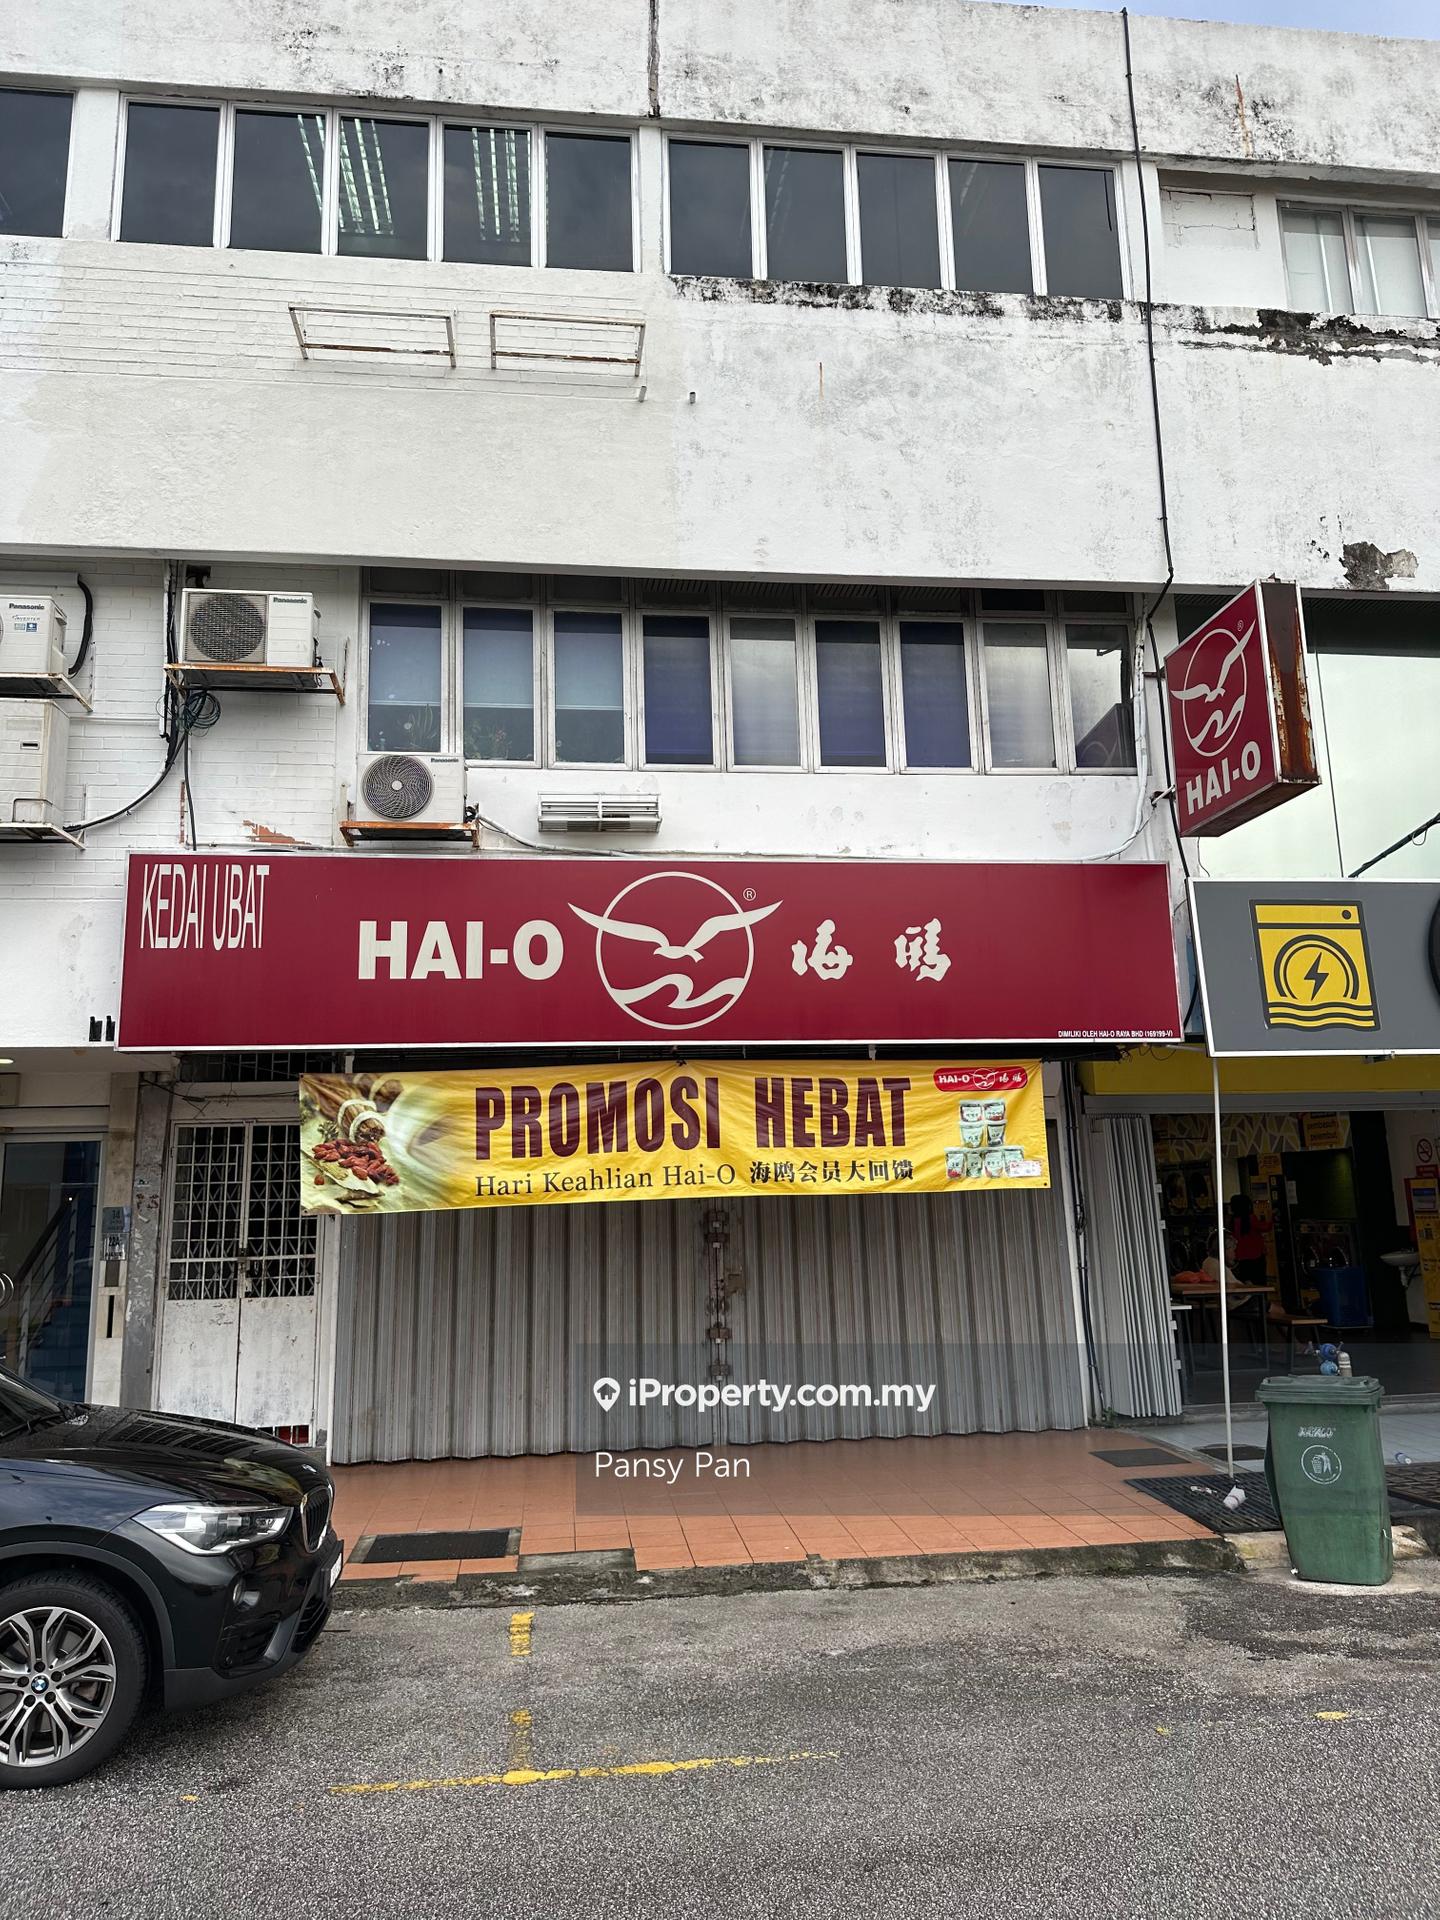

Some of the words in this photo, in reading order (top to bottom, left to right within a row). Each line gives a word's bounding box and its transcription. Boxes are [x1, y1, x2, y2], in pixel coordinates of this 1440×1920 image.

[8, 602, 45, 610] Panasonic
[1186, 740, 1262, 816] HAI-O
[140, 863, 206, 949] KEDAI
[212, 863, 270, 951] UBAT
[358, 919, 564, 981] HAI-O
[1058, 1030, 1081, 1038] DIMILIKI
[1082, 1030, 1098, 1038] OLEH
[1099, 1030, 1115, 1038] HAI-O
[1116, 1030, 1131, 1038] RAYA
[1132, 1030, 1144, 1038] BHD
[938, 1074, 971, 1084] HAI-O
[475, 1077, 721, 1160] PROMOSI
[754, 1077, 912, 1148] HEBAT
[475, 1172, 533, 1197] Hari
[543, 1166, 655, 1195] Keahlian
[663, 1163, 737, 1188] Hai-O
[749, 1159, 915, 1184] 海鸥会员大回馈
